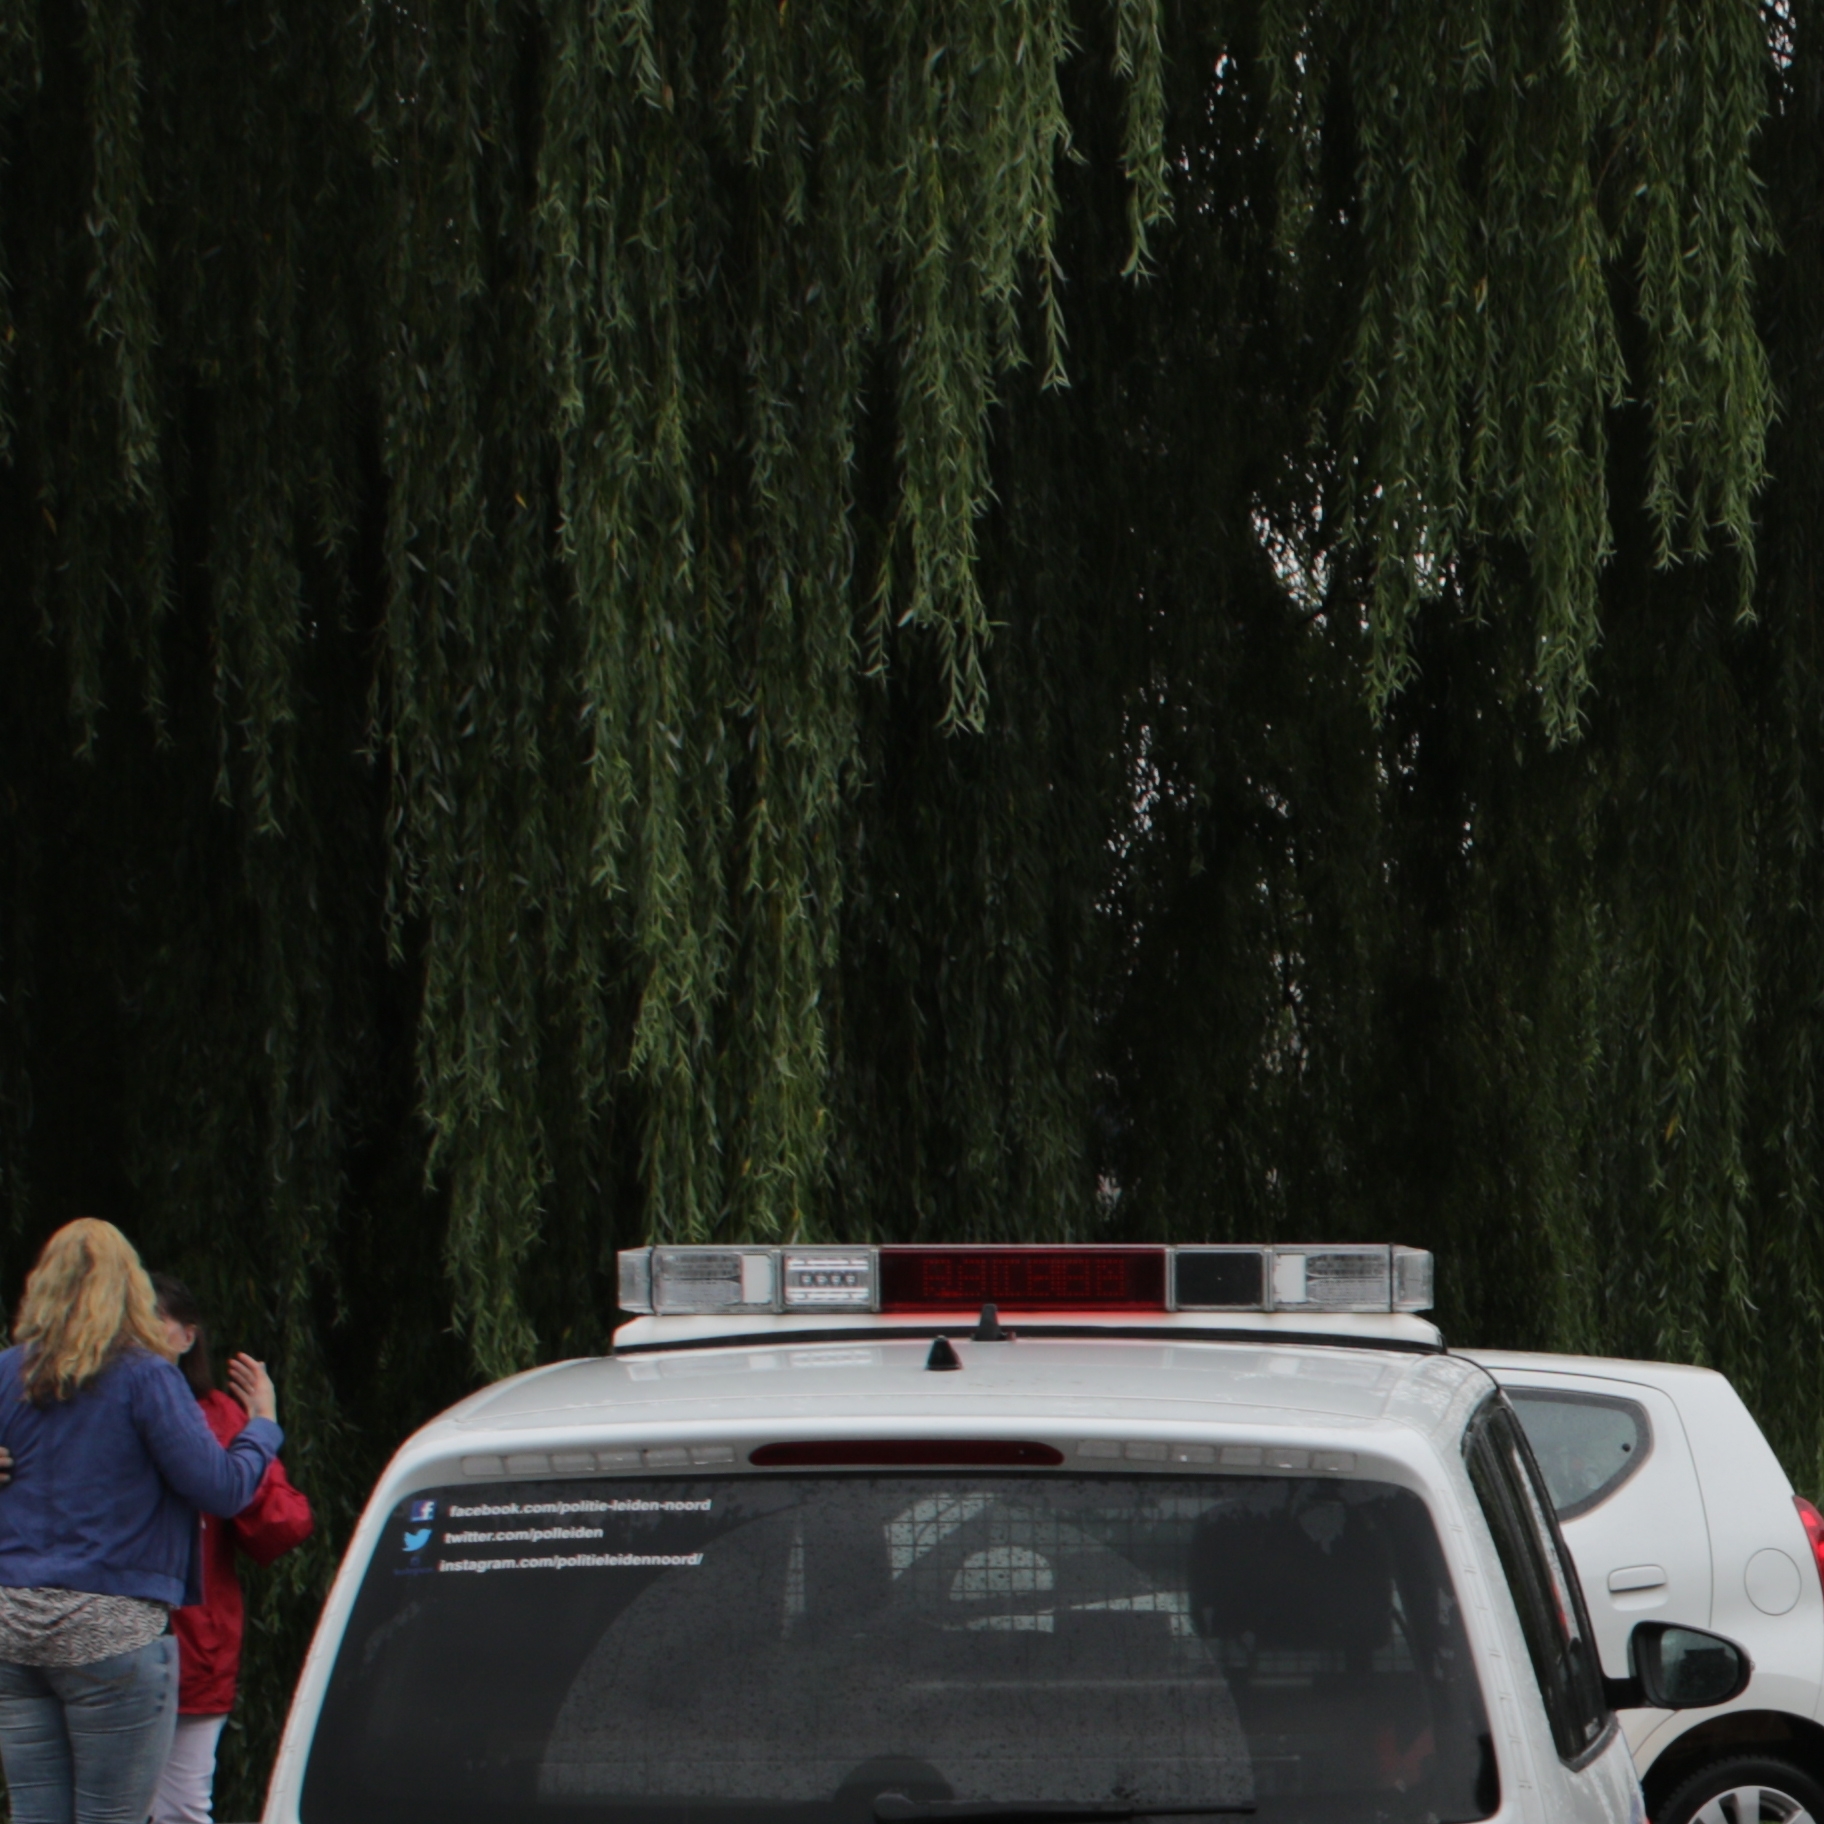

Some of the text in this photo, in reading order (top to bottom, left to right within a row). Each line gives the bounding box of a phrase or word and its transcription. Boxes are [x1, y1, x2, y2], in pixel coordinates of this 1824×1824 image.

[448, 1499, 712, 1518] facebook.com/politie-leiden-noord
[443, 1525, 605, 1544] twitter.com/polleiden
[438, 1552, 704, 1574] instagram.com/politieleidennoord/
